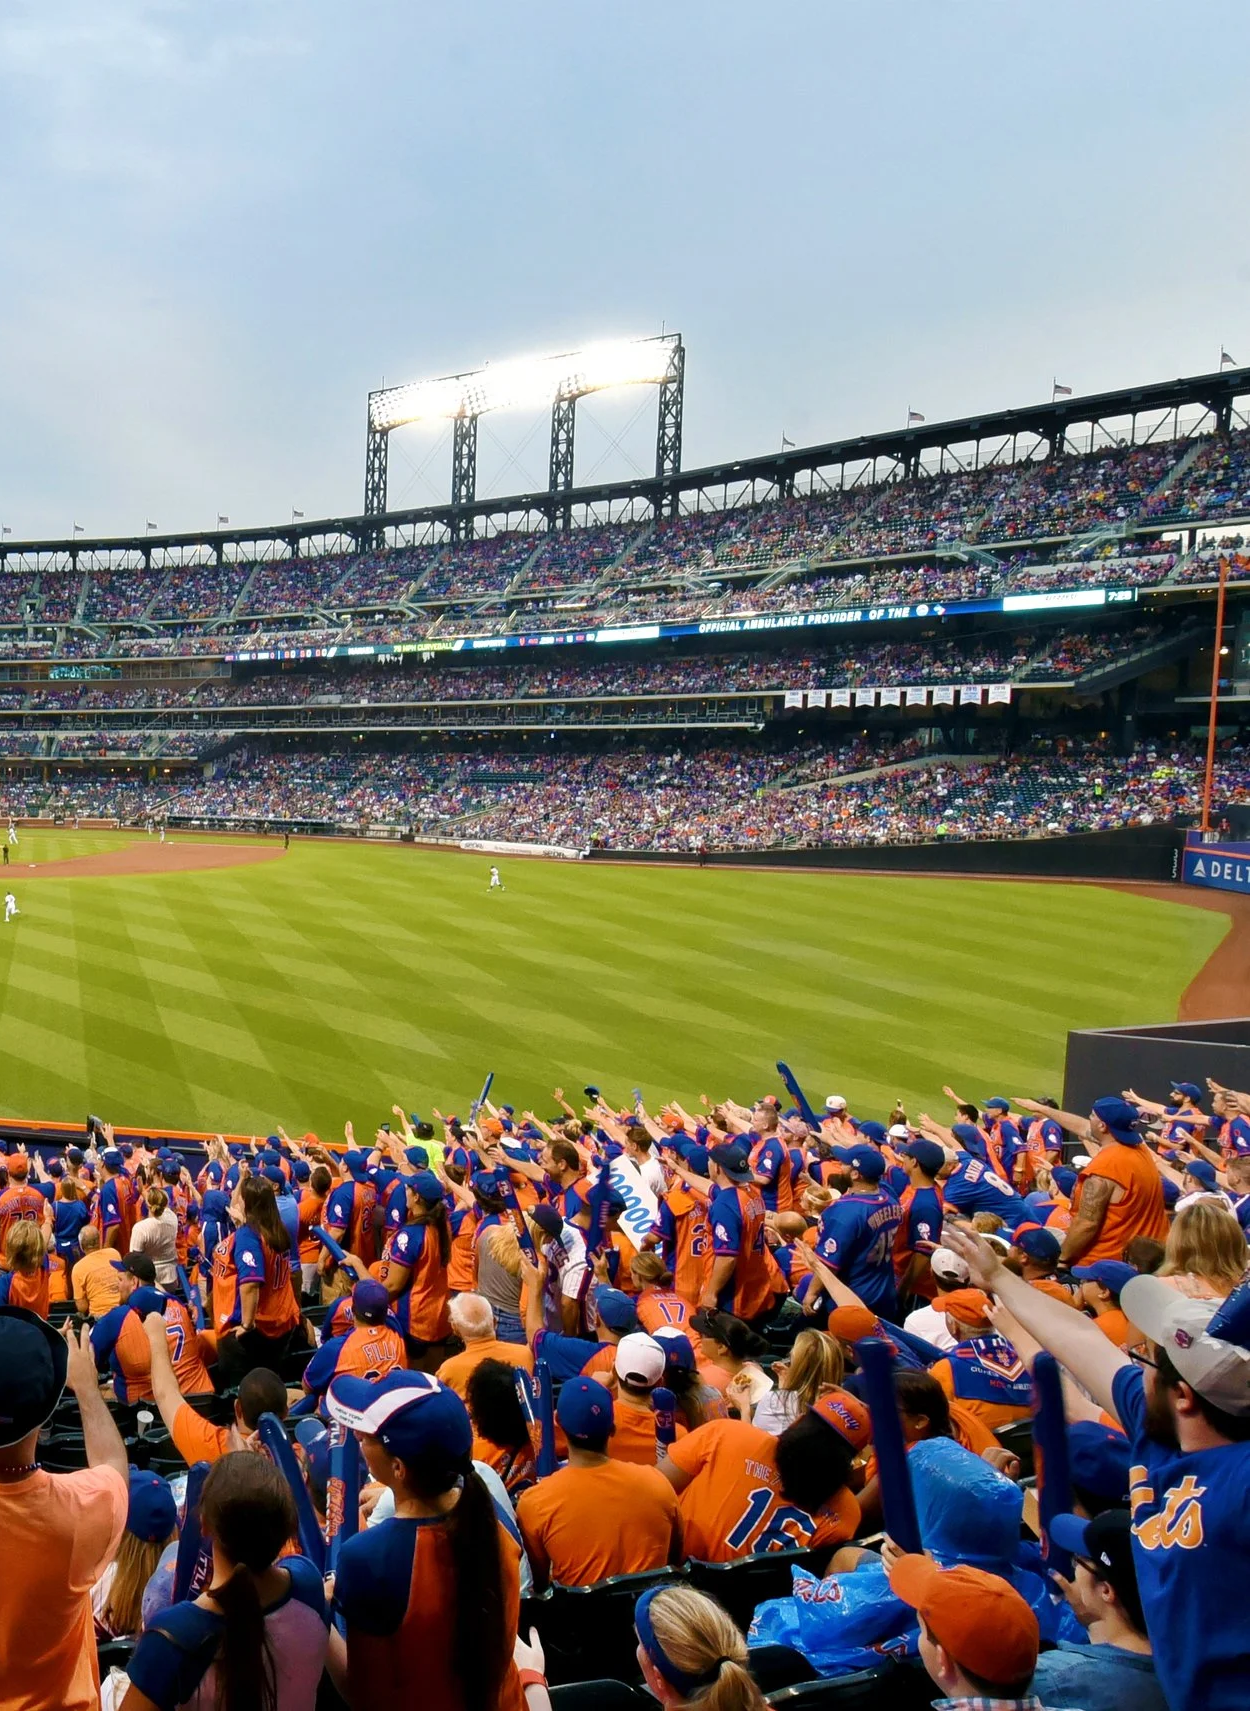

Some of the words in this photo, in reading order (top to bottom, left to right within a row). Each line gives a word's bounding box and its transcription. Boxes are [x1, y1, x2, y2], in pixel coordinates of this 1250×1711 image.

[698, 619, 740, 634] OFFICIAL
[744, 613, 805, 630] AMBULANCE
[807, 608, 861, 625] PROVIDER
[869, 608, 885, 620] OF
[887, 605, 910, 619] THE
[402, 643, 416, 652] MPH
[417, 641, 453, 651] CURVEBALL
[983, 1171, 1014, 1196] 8
[657, 1301, 686, 1325] 17
[826, 1400, 862, 1431] Army
[744, 1458, 773, 1482] THE
[724, 1486, 818, 1554] 16
